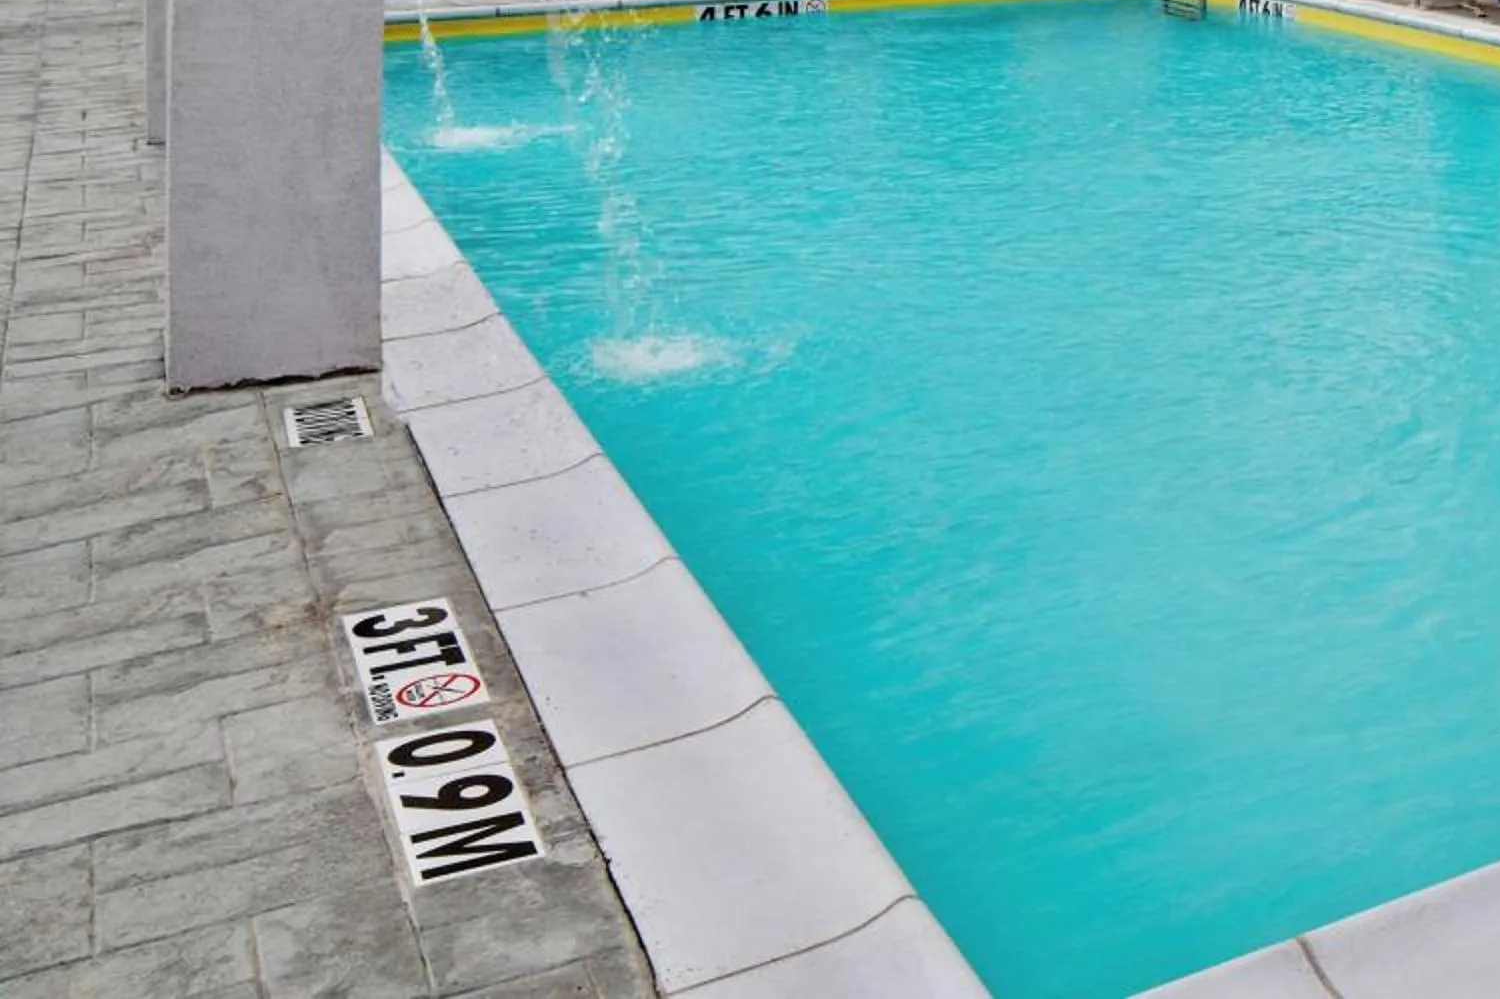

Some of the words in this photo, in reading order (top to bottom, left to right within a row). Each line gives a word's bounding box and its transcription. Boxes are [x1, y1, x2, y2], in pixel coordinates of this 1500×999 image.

[723, 4, 748, 19] FT
[778, 0, 799, 16] IN
[352, 607, 448, 638] 3
[363, 631, 466, 681] FT.
[388, 730, 539, 880] 0.9M
